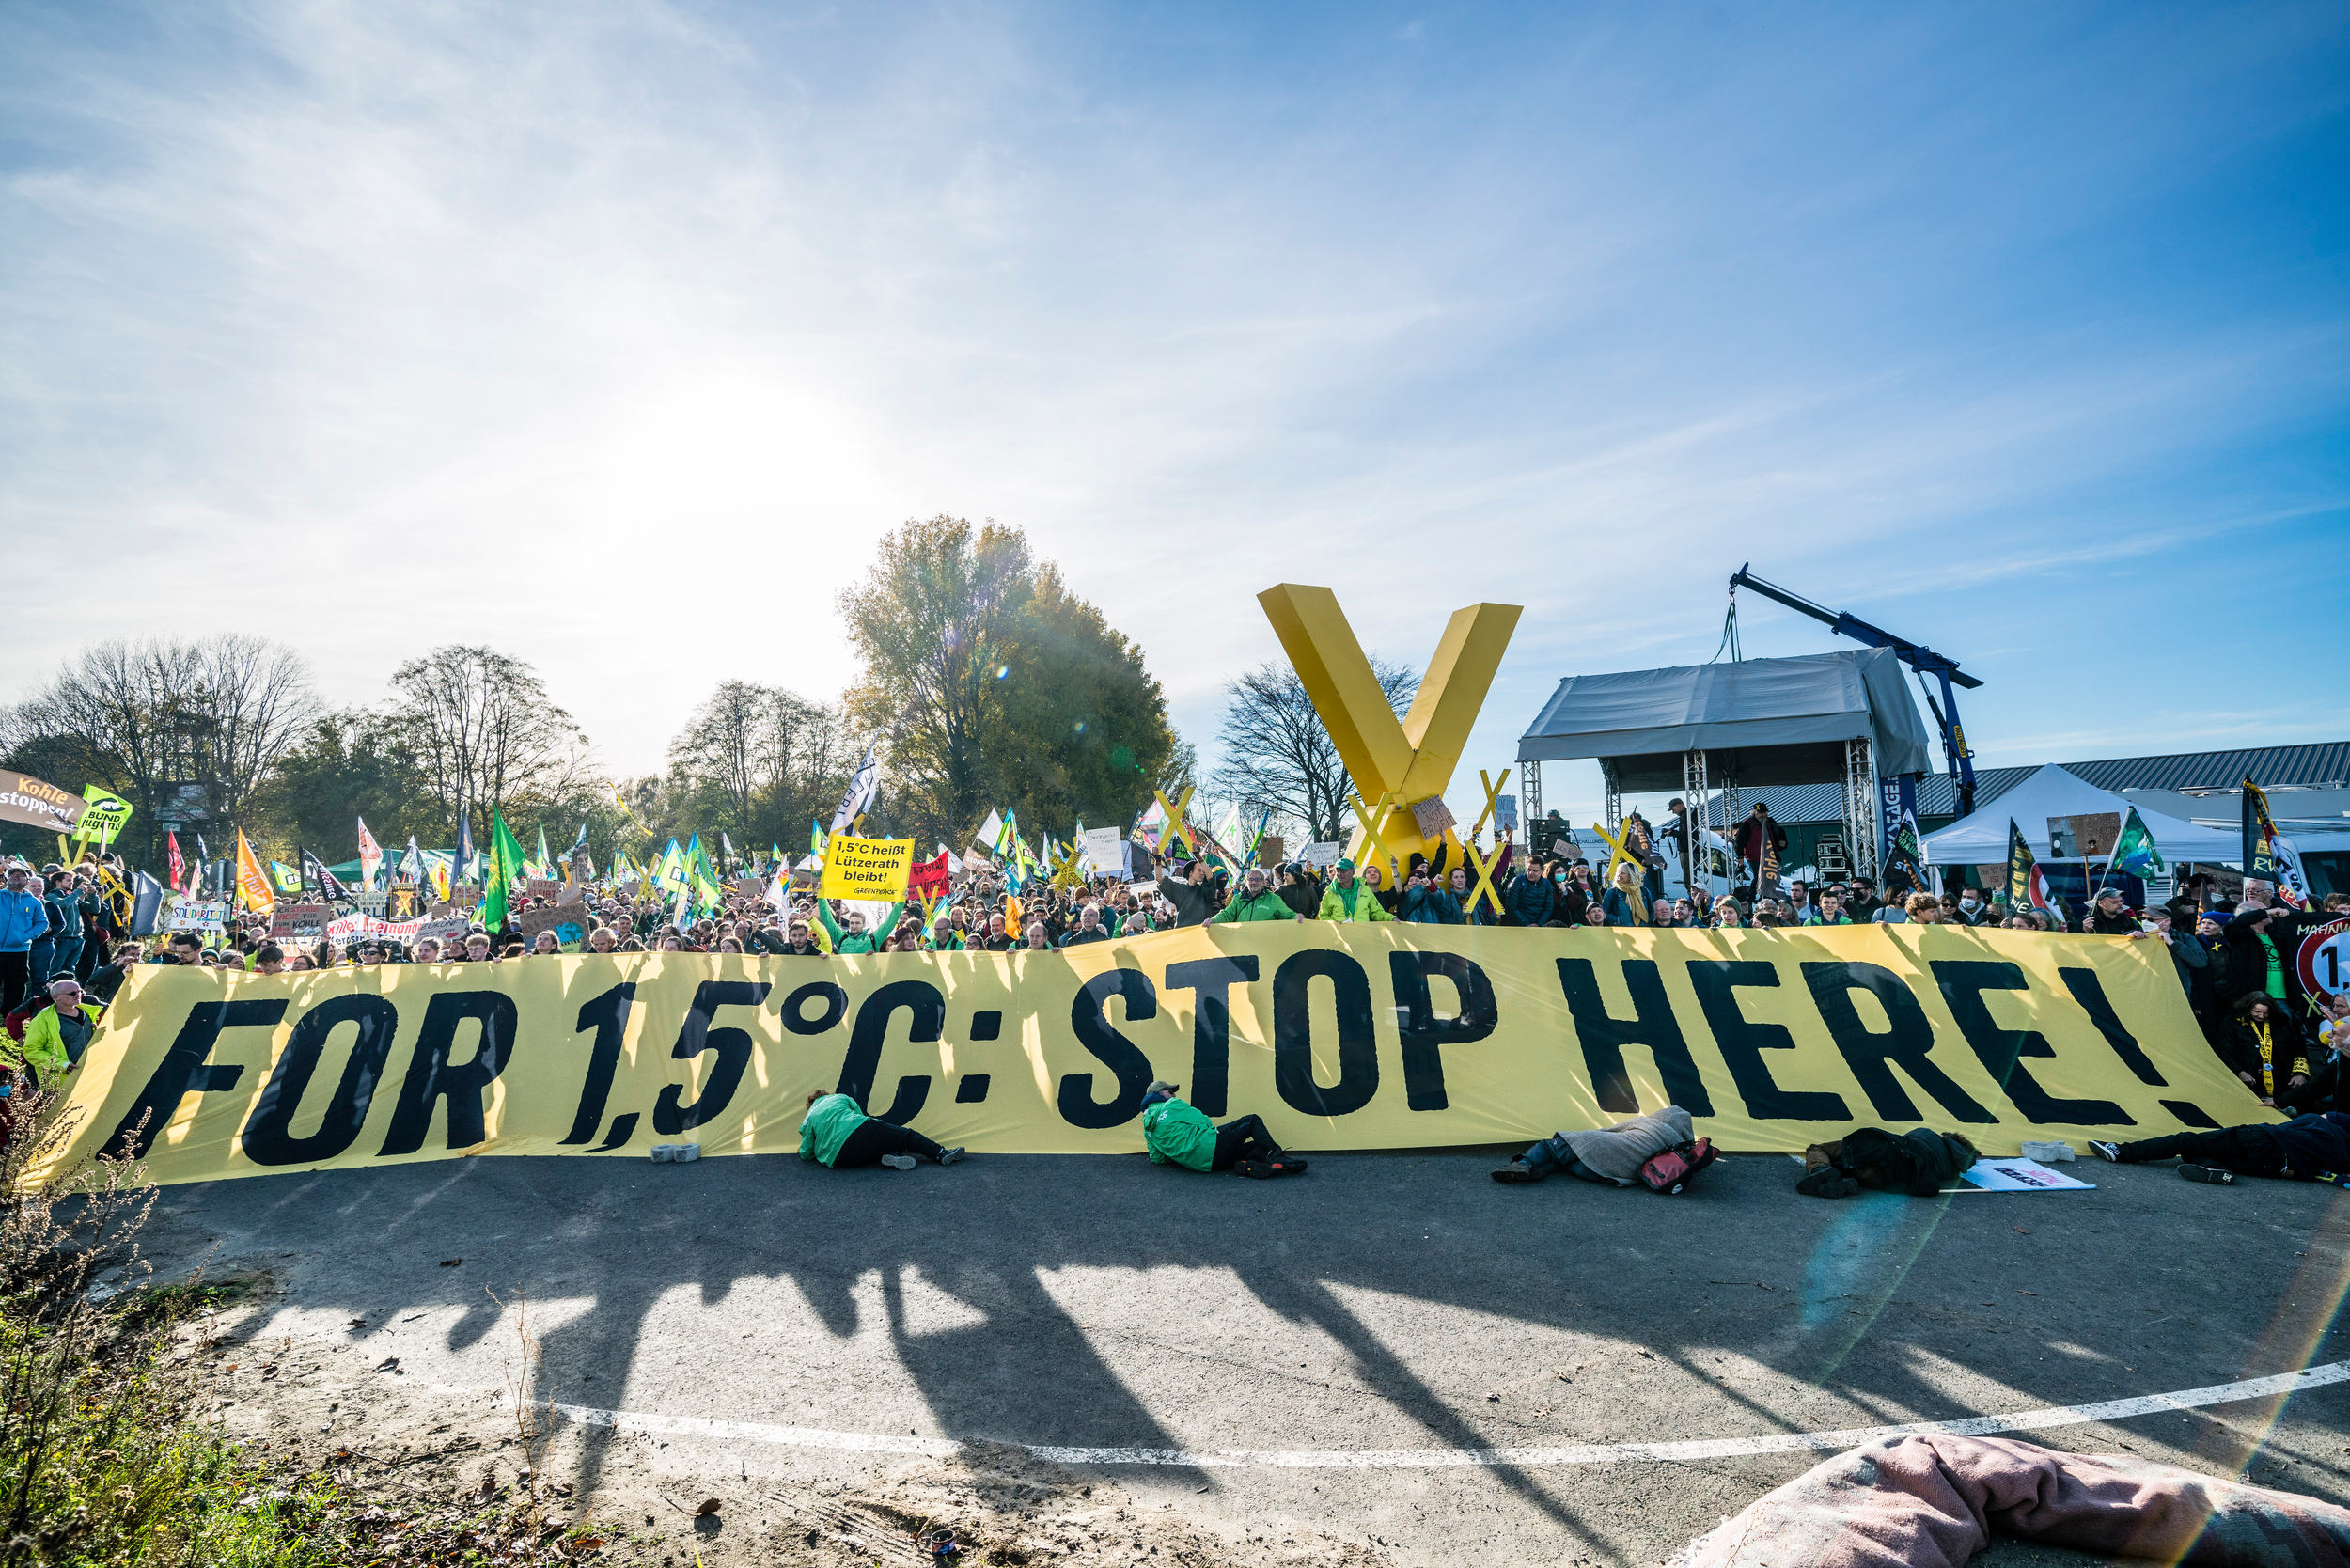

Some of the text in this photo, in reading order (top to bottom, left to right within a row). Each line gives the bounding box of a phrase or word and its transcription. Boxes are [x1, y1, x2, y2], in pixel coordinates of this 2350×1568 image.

[1954, 726, 1967, 756] PALFINGER
[18, 777, 68, 805] Kohle
[0, 792, 74, 822] stoppen!
[1413, 796, 1444, 817] PEOPLE
[87, 811, 120, 823] BUND
[1426, 808, 1444, 824] NOT
[81, 817, 121, 831] jugnd
[1422, 815, 1457, 839] PROFIT
[838, 841, 906, 855] 1,5°C heißt
[835, 855, 900, 869] Lützerath
[843, 870, 887, 883] bleibt!
[275, 913, 300, 921] NICHT
[292, 919, 321, 929] KOHLE
[419, 918, 469, 931] ZUKUNFT
[96, 990, 518, 1168] FOR
[1058, 949, 1498, 1131] STOP
[1556, 957, 2224, 1129] HERE!
